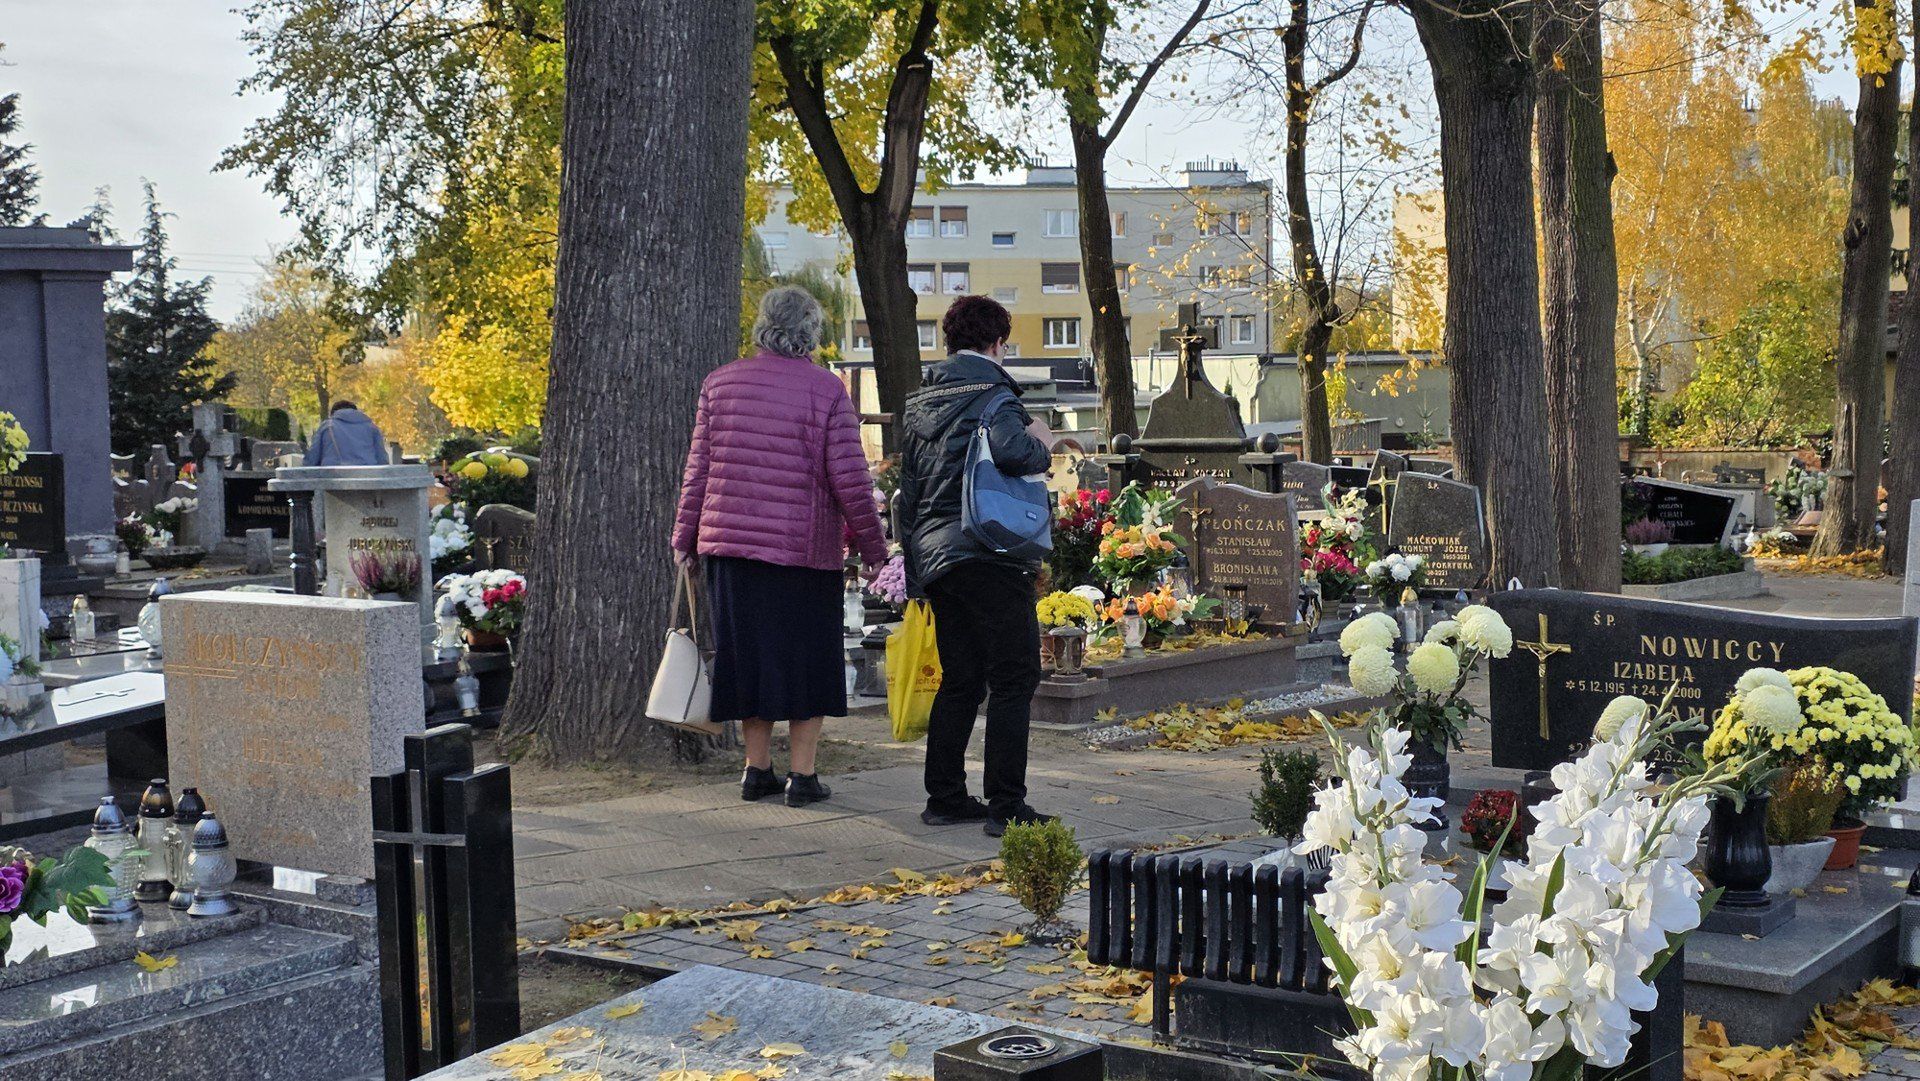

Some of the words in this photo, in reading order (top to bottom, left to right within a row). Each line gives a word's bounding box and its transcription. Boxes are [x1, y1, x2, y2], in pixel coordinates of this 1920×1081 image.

[1216, 536, 1271, 547] STANISŁAW
[1212, 562, 1279, 576] BRONISŁAWA
[1640, 634, 1785, 663] NOWICCY
[1613, 661, 1695, 683] IZABELA
